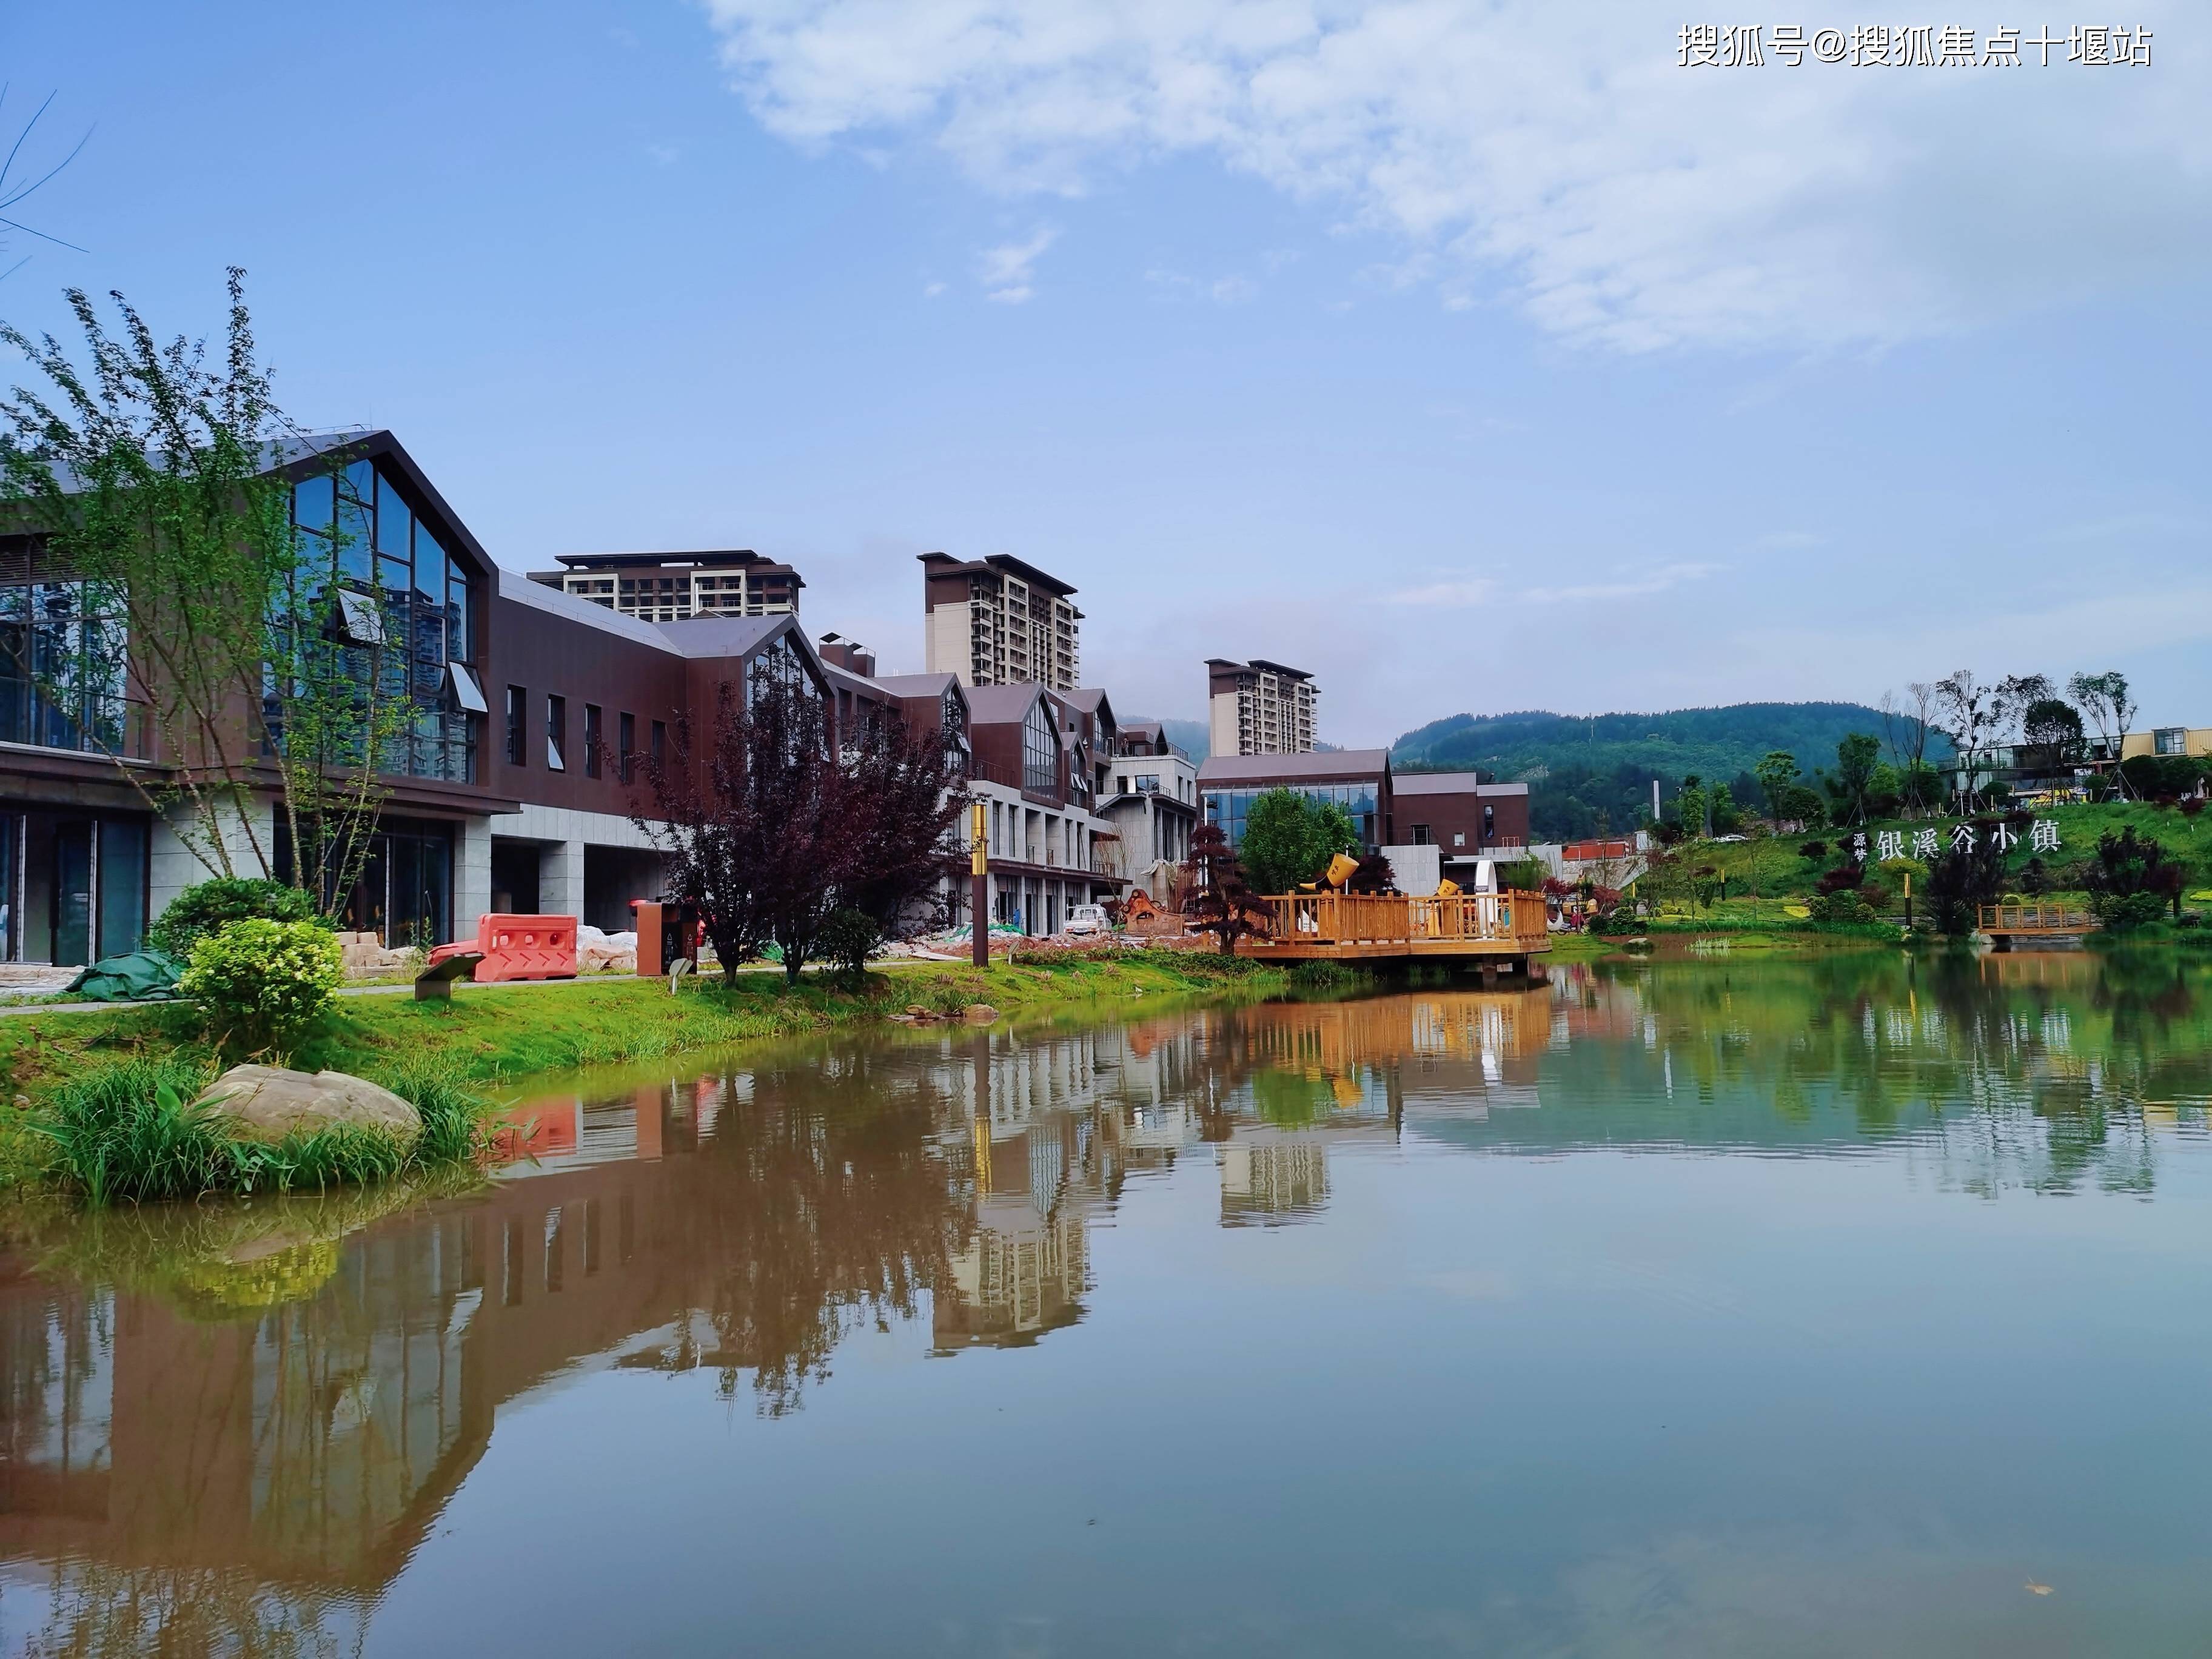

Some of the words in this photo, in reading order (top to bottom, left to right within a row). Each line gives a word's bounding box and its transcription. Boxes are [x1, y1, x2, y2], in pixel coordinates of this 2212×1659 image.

[1854, 833, 1868, 862] 源梦
[1876, 820, 2062, 861] 银溪谷小镇
